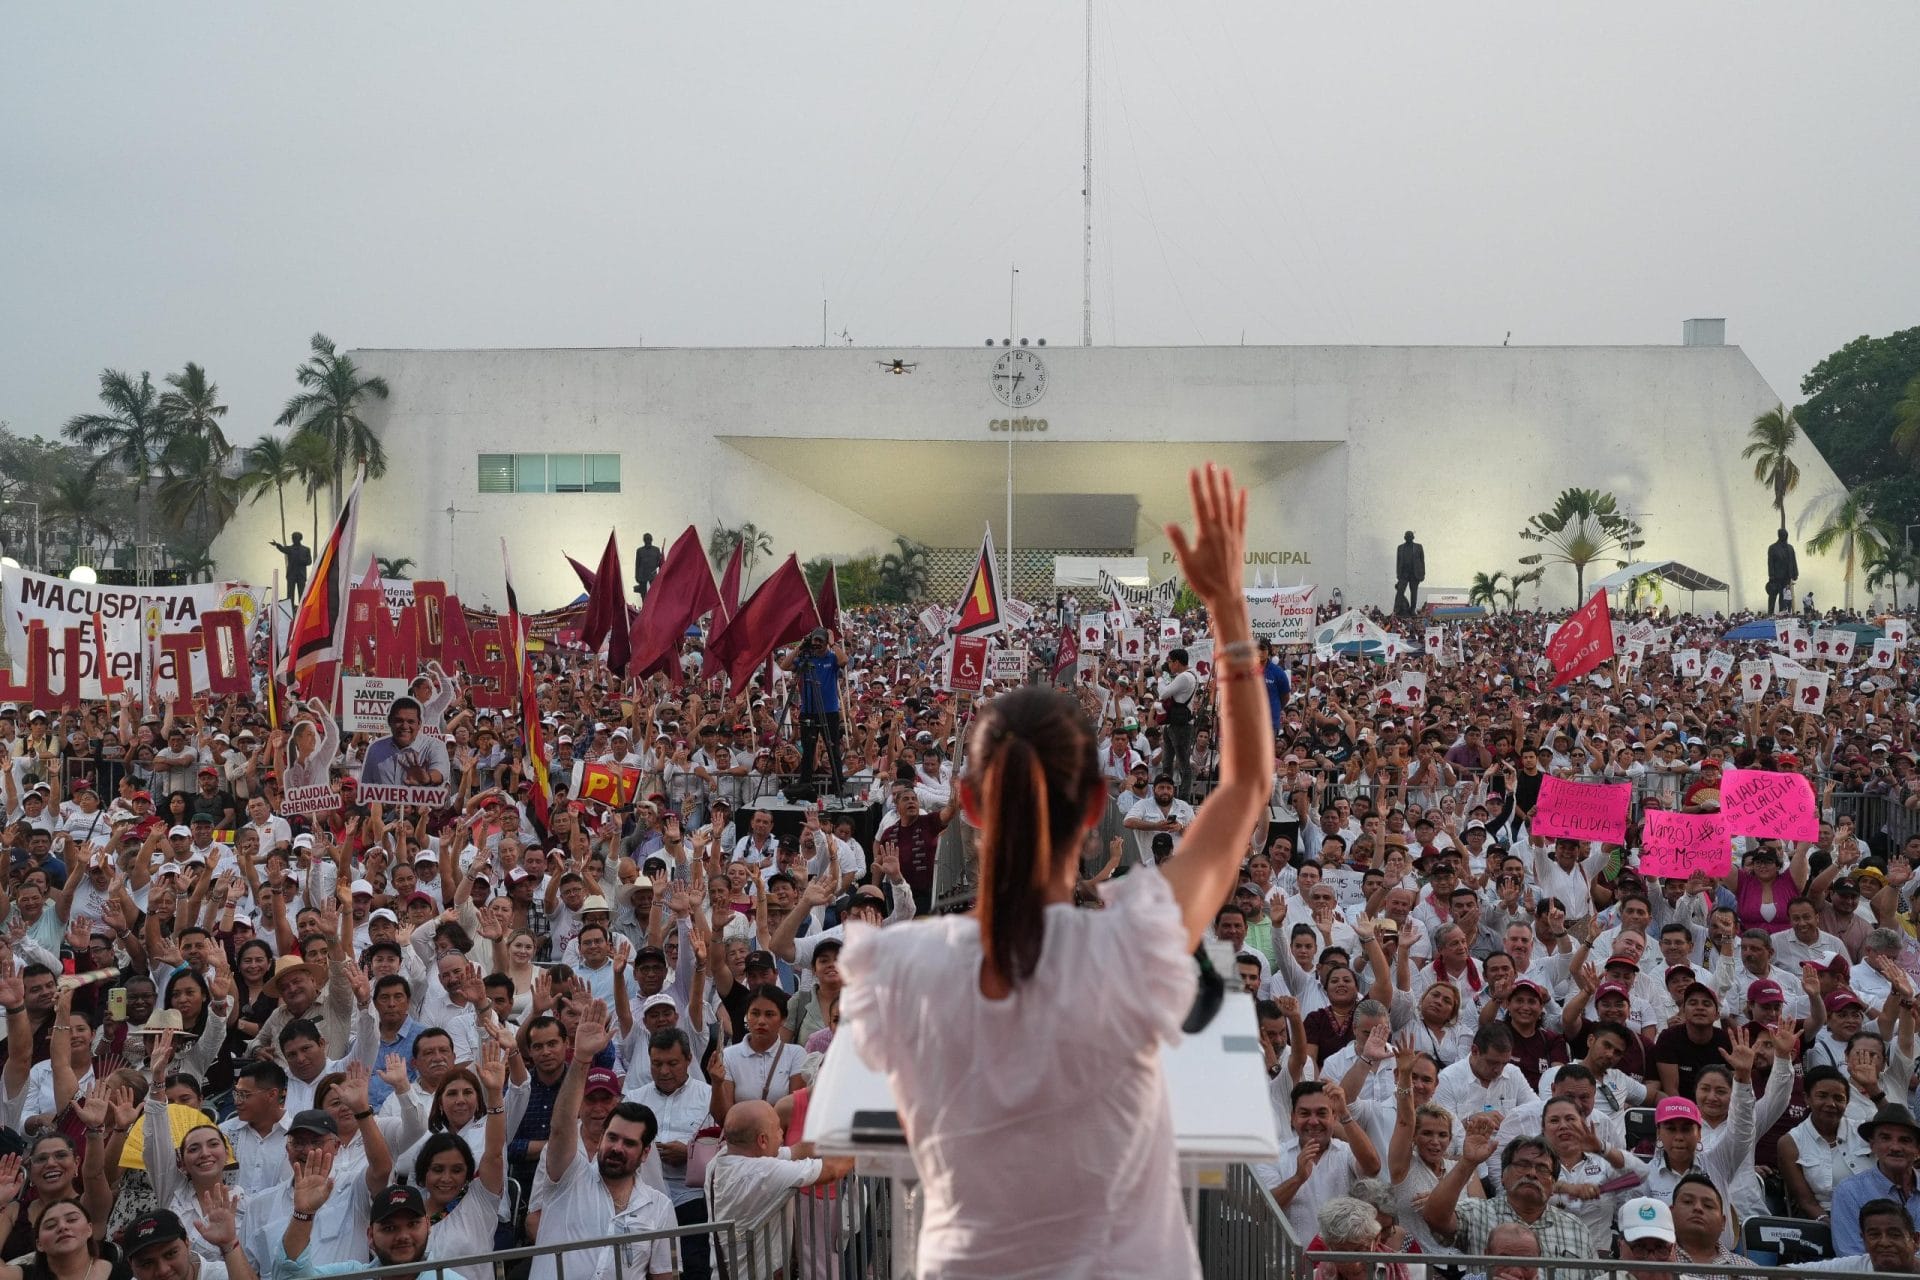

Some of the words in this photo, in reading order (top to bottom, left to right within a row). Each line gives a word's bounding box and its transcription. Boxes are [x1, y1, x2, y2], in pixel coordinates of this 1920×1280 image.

[989, 416, 1049, 432] centro
[1244, 552, 1311, 565] UNICIPAL
[1279, 605, 1313, 616] Tabasco
[1282, 617, 1303, 627] XXVI
[354, 690, 395, 699] JAVIER
[357, 701, 390, 714] MAY
[288, 786, 331, 801] CLAUDIA
[359, 786, 408, 801] JAVIER
[412, 790, 445, 805] MAY
[1725, 774, 1773, 810] ALIADOS
[1743, 775, 1796, 815] CLAUDIA
[281, 797, 340, 815] SHEINBAUM
[1758, 801, 1787, 826] MAY
[1549, 812, 1611, 833] CLAUDIA
[1665, 1104, 1690, 1113] morena
